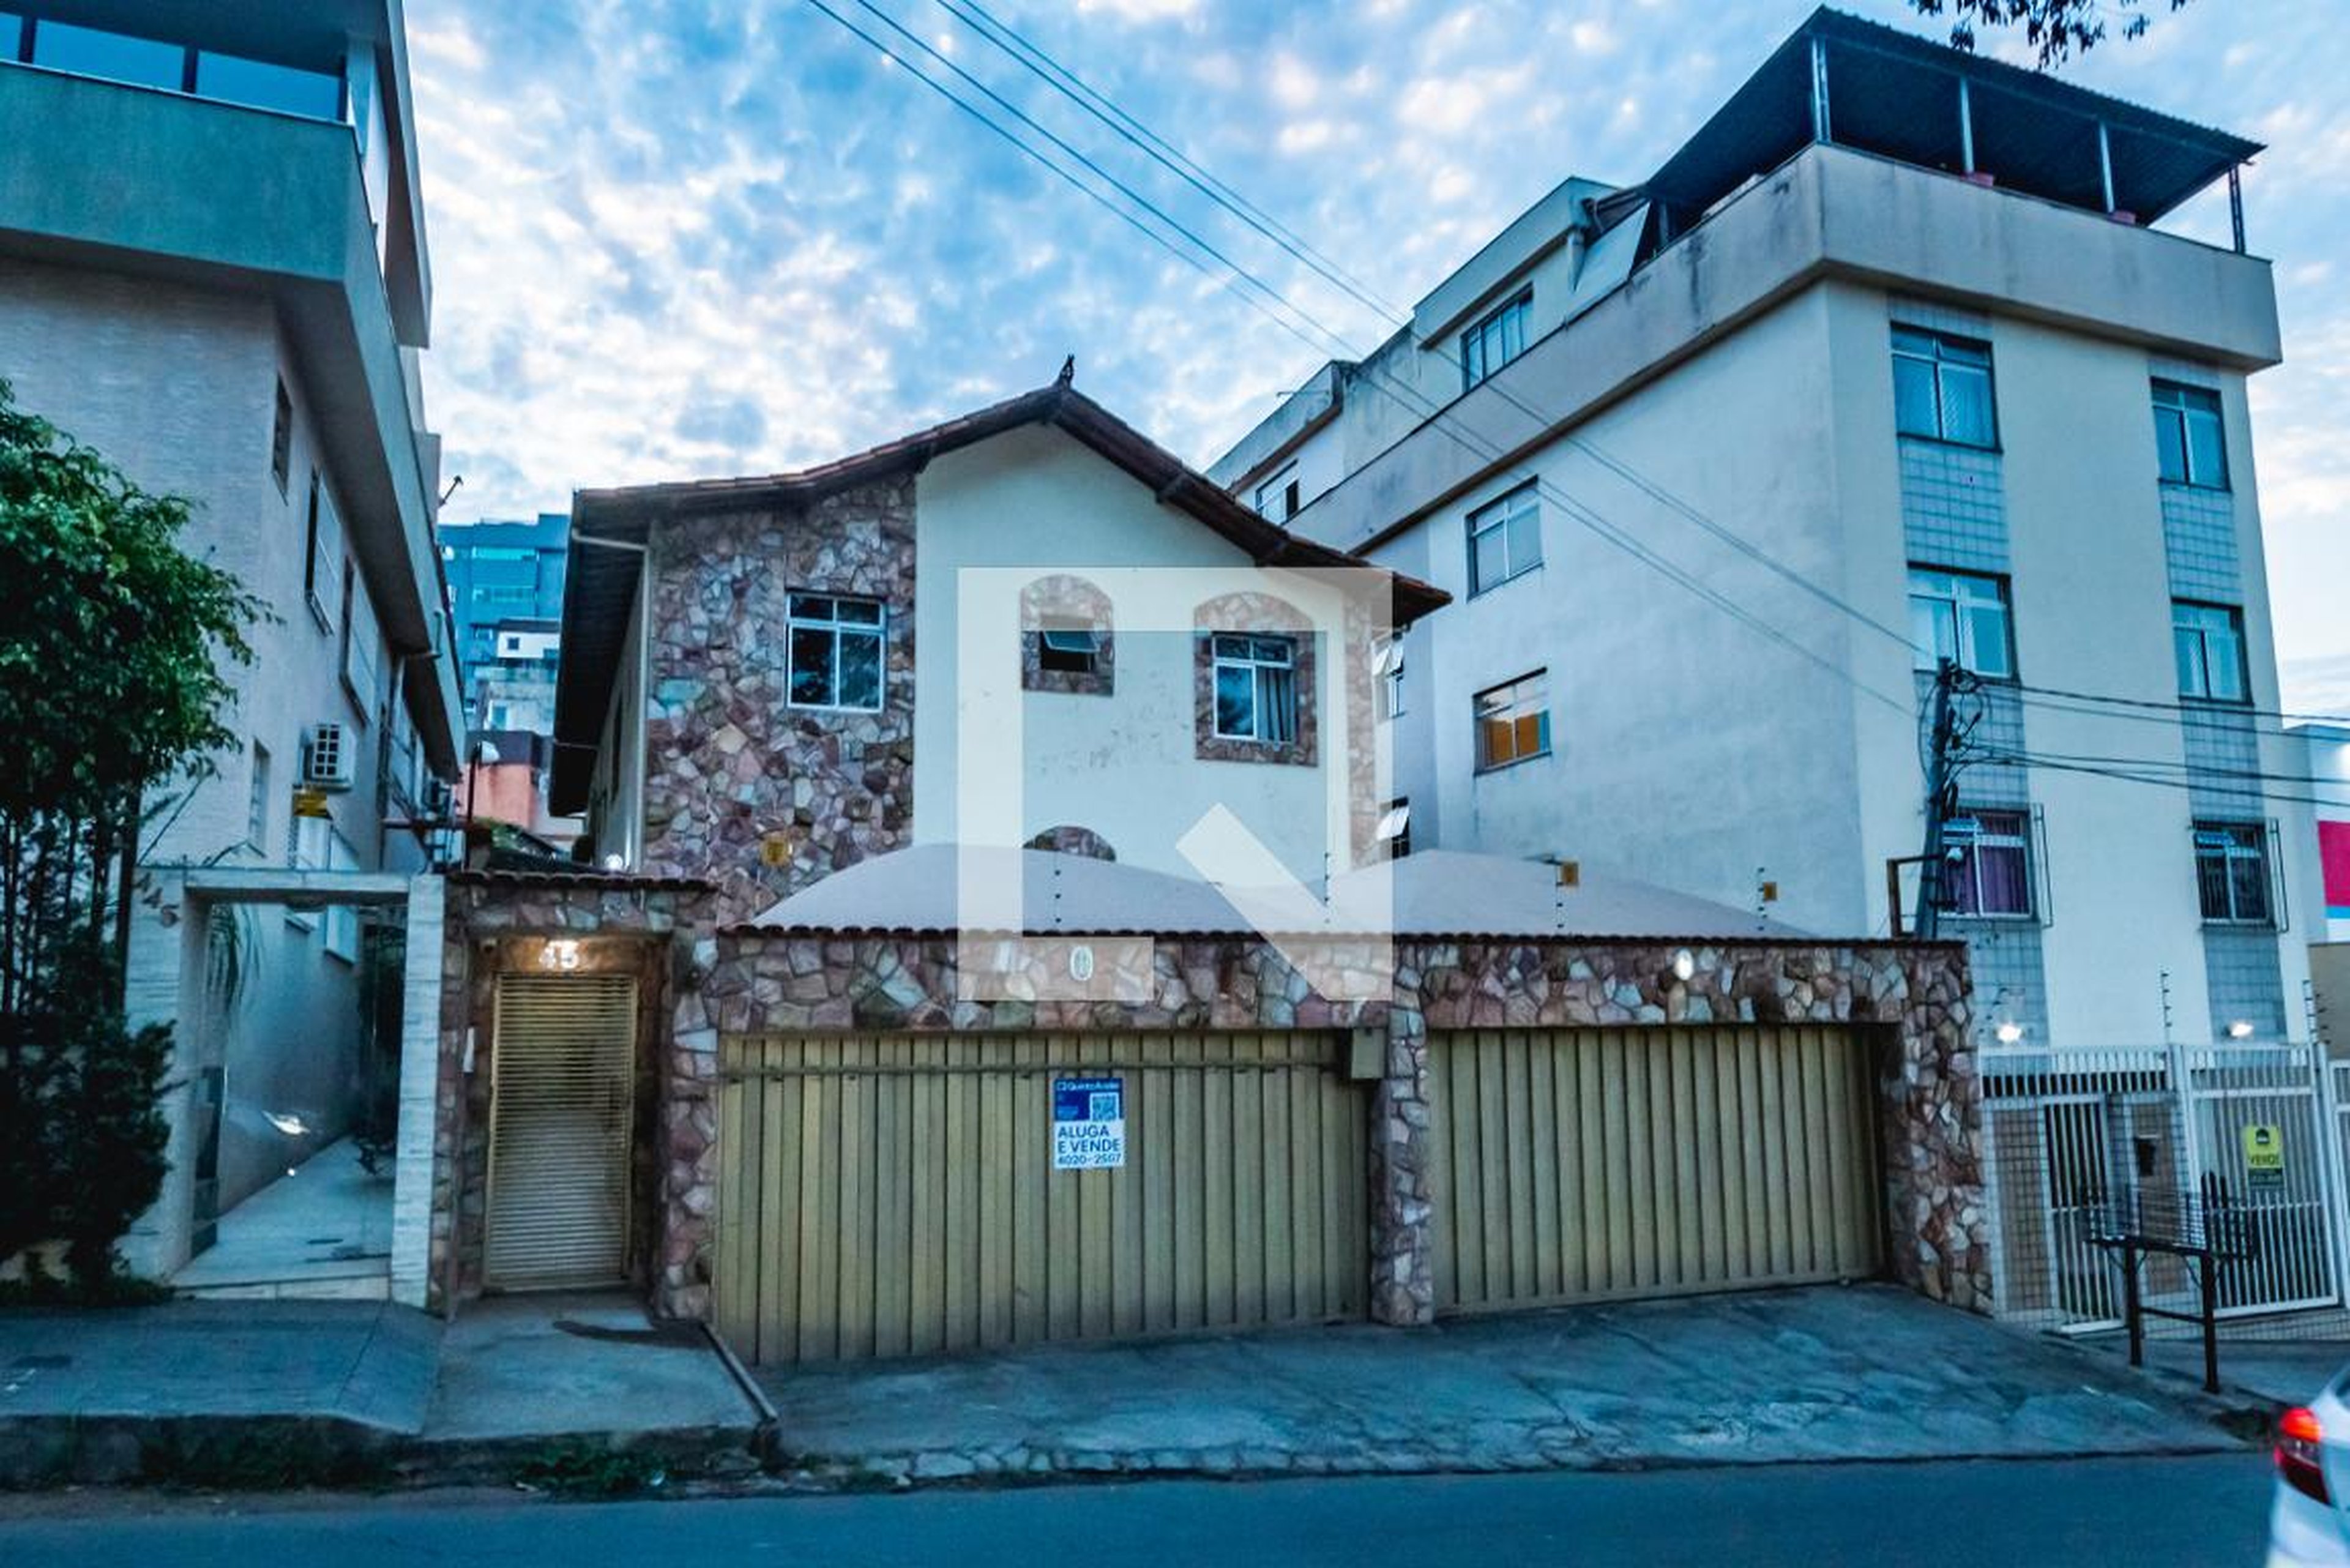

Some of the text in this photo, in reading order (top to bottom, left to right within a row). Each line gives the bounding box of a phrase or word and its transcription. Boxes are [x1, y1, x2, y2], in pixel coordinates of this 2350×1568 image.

[1058, 1124, 1110, 1138] ALUGA
[1058, 1138, 1121, 1154] E VENDE
